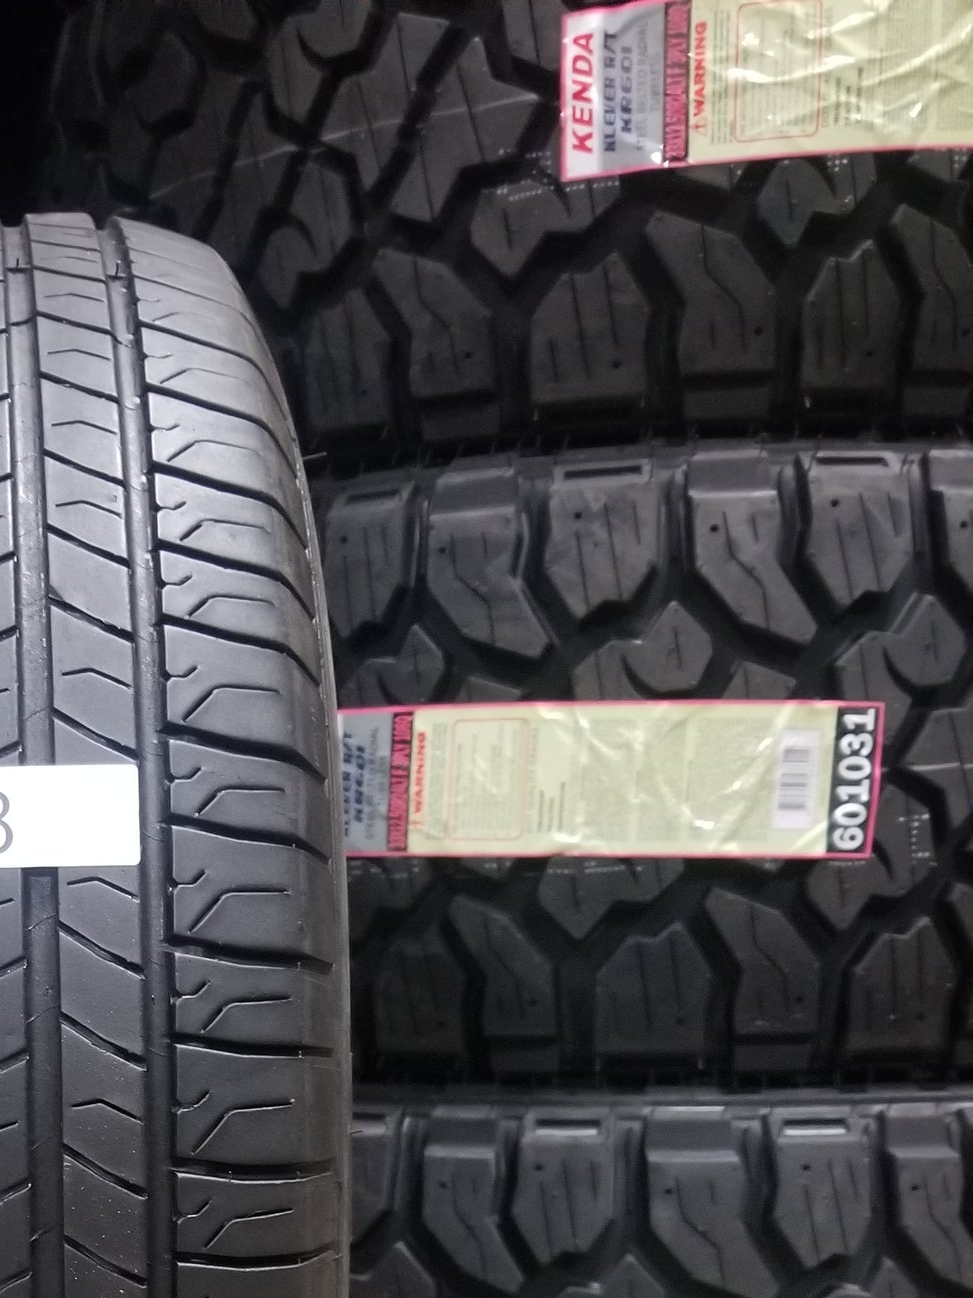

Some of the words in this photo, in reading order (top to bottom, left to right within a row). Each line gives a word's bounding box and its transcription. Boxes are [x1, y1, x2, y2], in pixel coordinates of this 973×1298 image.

[603, 28, 618, 69] R/T
[693, 21, 707, 117] WARNING
[572, 32, 594, 154] KENDA
[603, 77, 617, 152] KLEVER
[413, 732, 426, 813] WARNING
[832, 708, 876, 850] 601031
